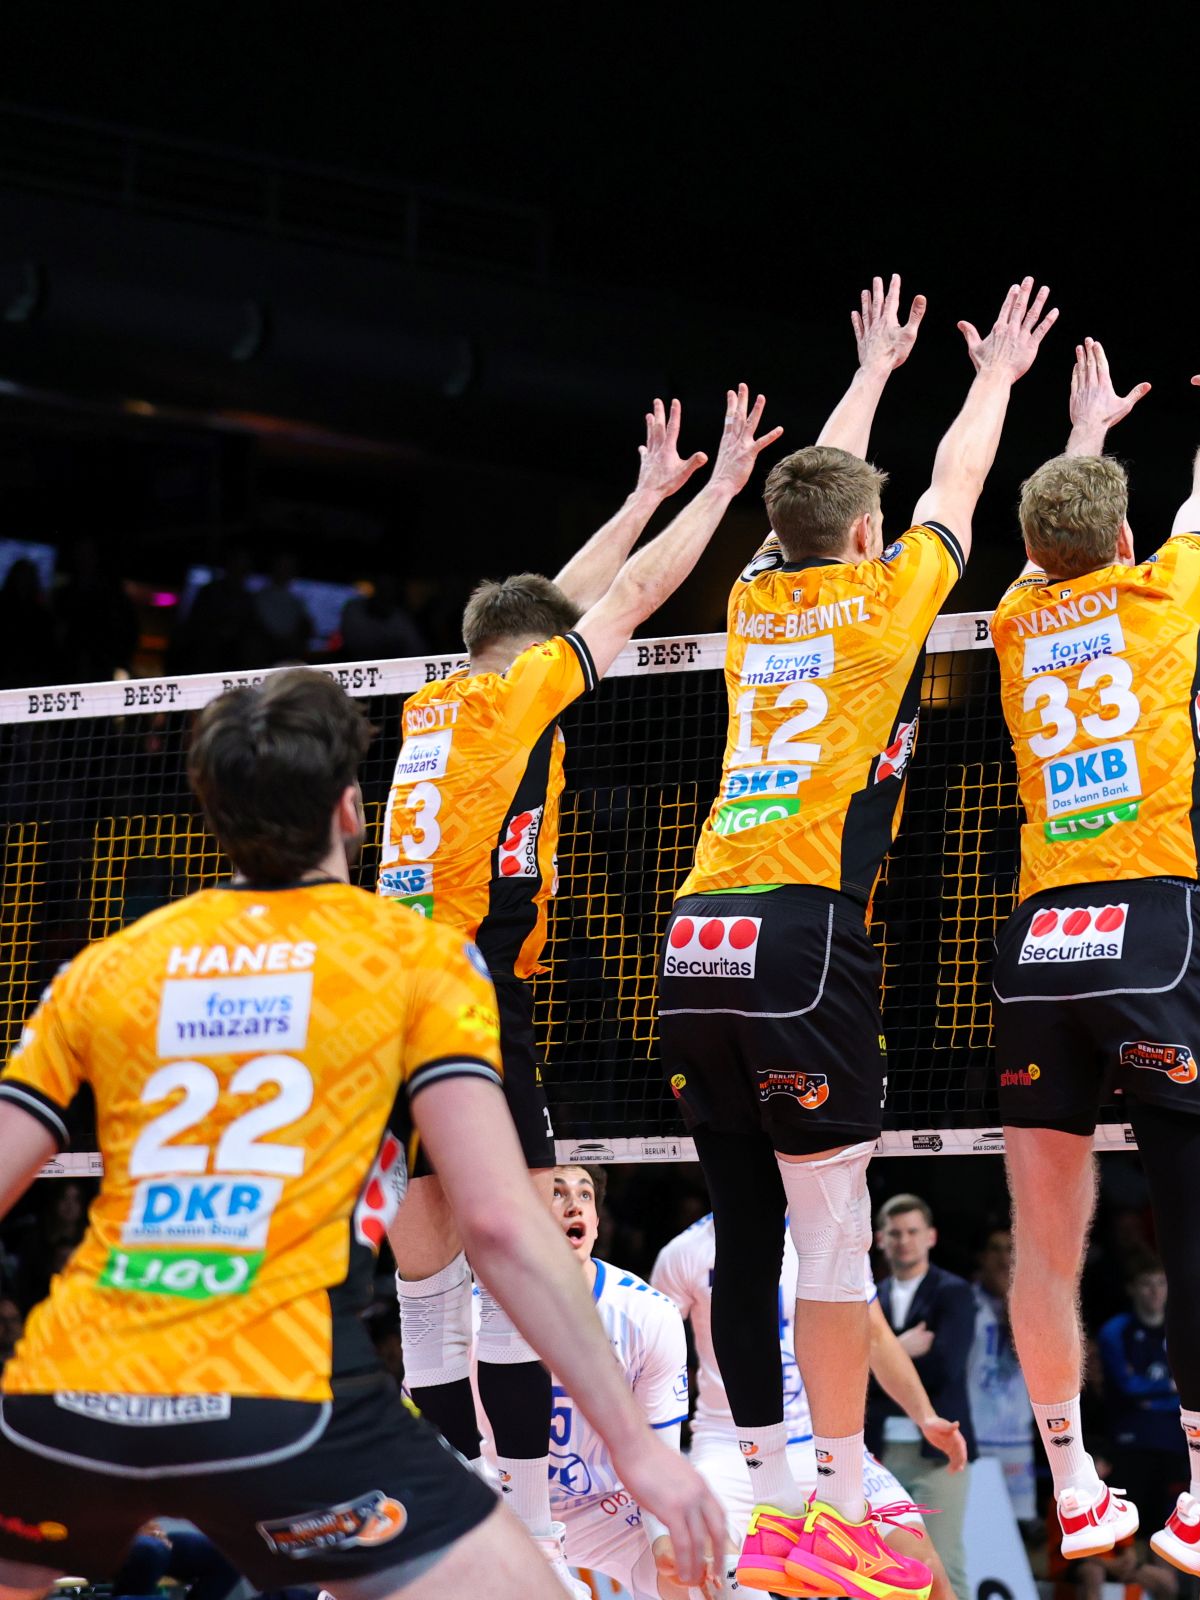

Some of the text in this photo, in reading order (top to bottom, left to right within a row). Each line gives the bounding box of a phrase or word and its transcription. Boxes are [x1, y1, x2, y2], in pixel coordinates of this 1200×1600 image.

[737, 596, 870, 639] RAGE-BREWITZ
[1011, 586, 1119, 637] IVANOV
[747, 666, 820, 685] mazars
[406, 701, 460, 732] SCHOTT
[1022, 655, 1141, 759] 33
[728, 681, 829, 768] 12
[1051, 748, 1128, 795] DKB
[1052, 782, 1129, 810] Das kann Bank
[168, 941, 317, 976] HANES
[666, 956, 752, 976] Securitas
[1021, 943, 1119, 962] Securitas
[176, 1014, 290, 1041] mazars
[129, 1054, 314, 1177] 22
[644, 1147, 666, 1155] BERLIN
